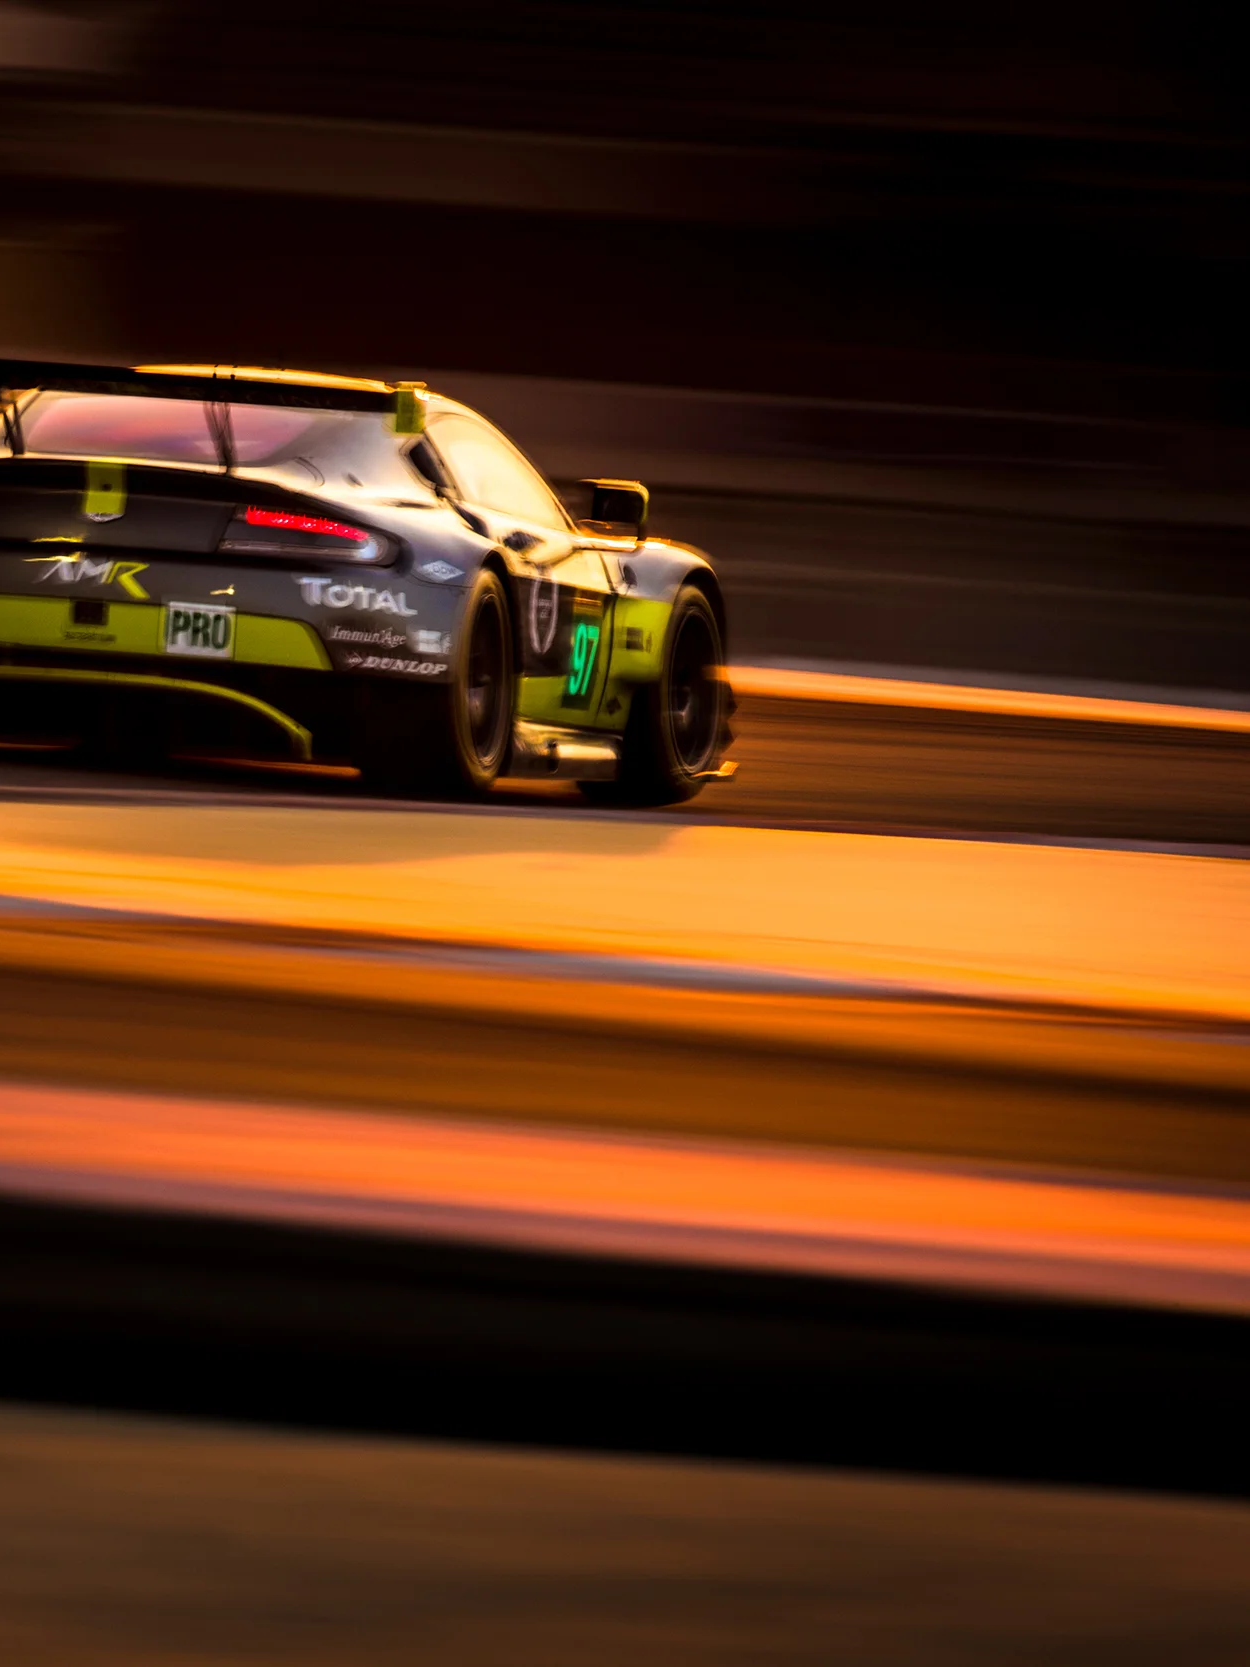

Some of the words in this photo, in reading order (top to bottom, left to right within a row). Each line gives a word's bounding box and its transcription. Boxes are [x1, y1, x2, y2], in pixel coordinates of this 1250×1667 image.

[301, 577, 417, 615] TOTAL
[170, 609, 231, 650] PRO
[364, 655, 447, 675] DUNLOP
[569, 622, 599, 695] 97
